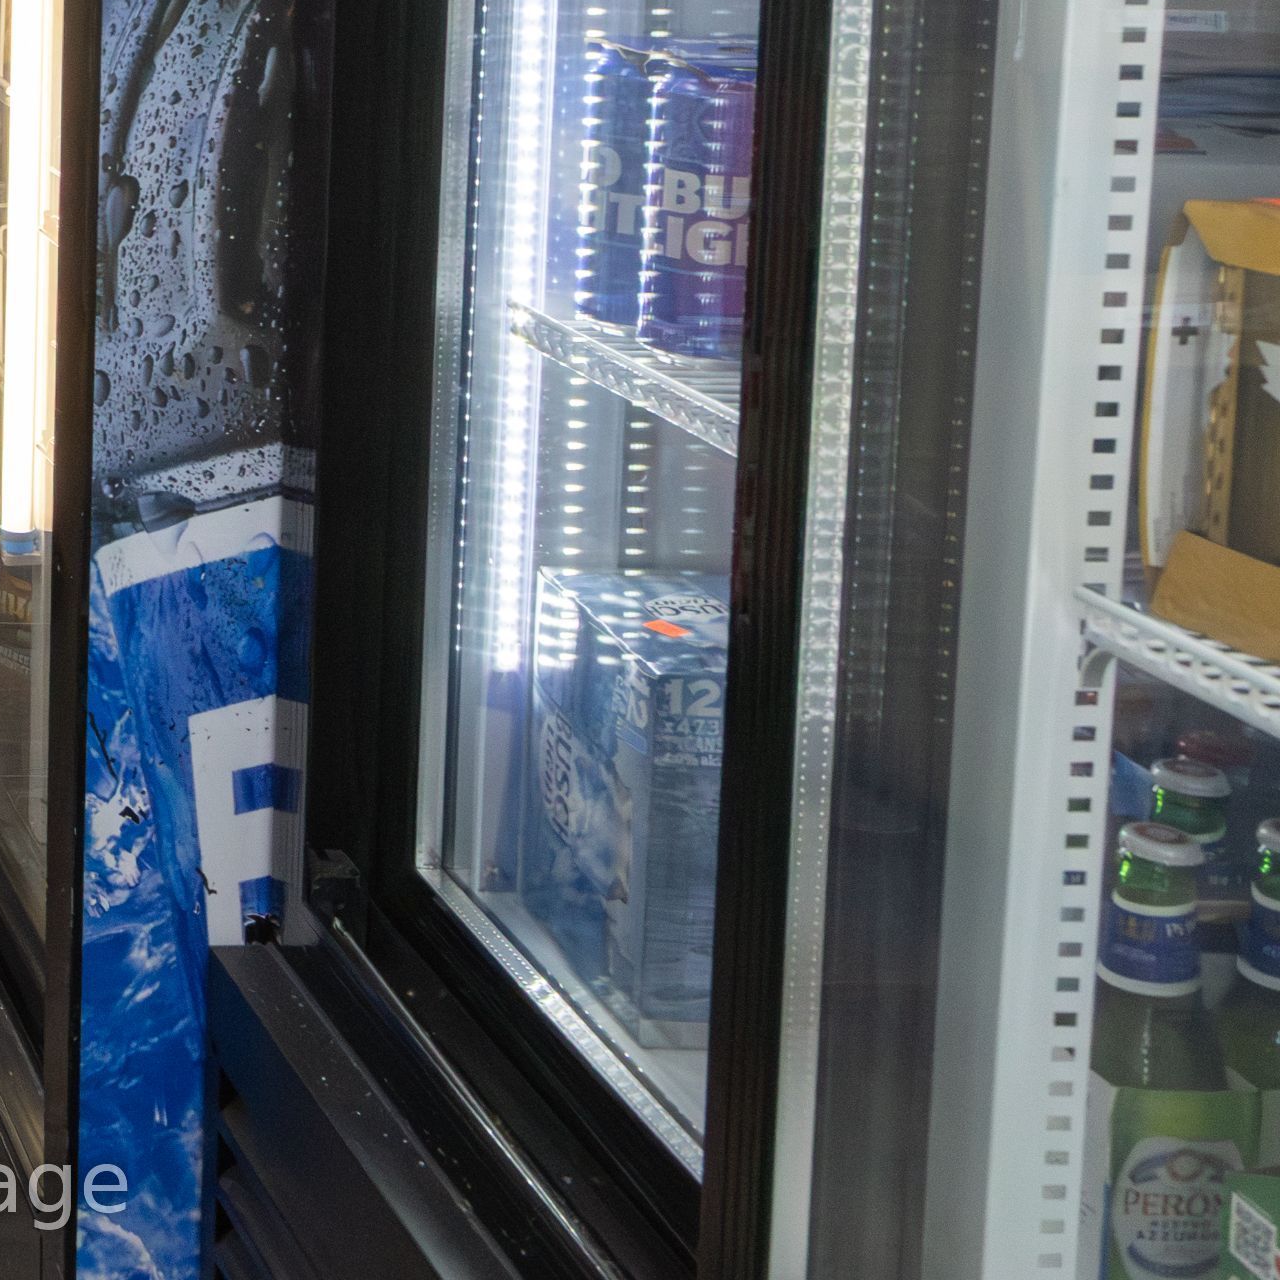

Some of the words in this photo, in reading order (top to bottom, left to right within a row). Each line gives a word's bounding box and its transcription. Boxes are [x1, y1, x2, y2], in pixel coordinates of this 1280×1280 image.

[662, 167, 751, 221] BU
[665, 678, 722, 719] 12
[678, 720, 721, 736] 473
[1123, 1188, 1223, 1219] PERON
